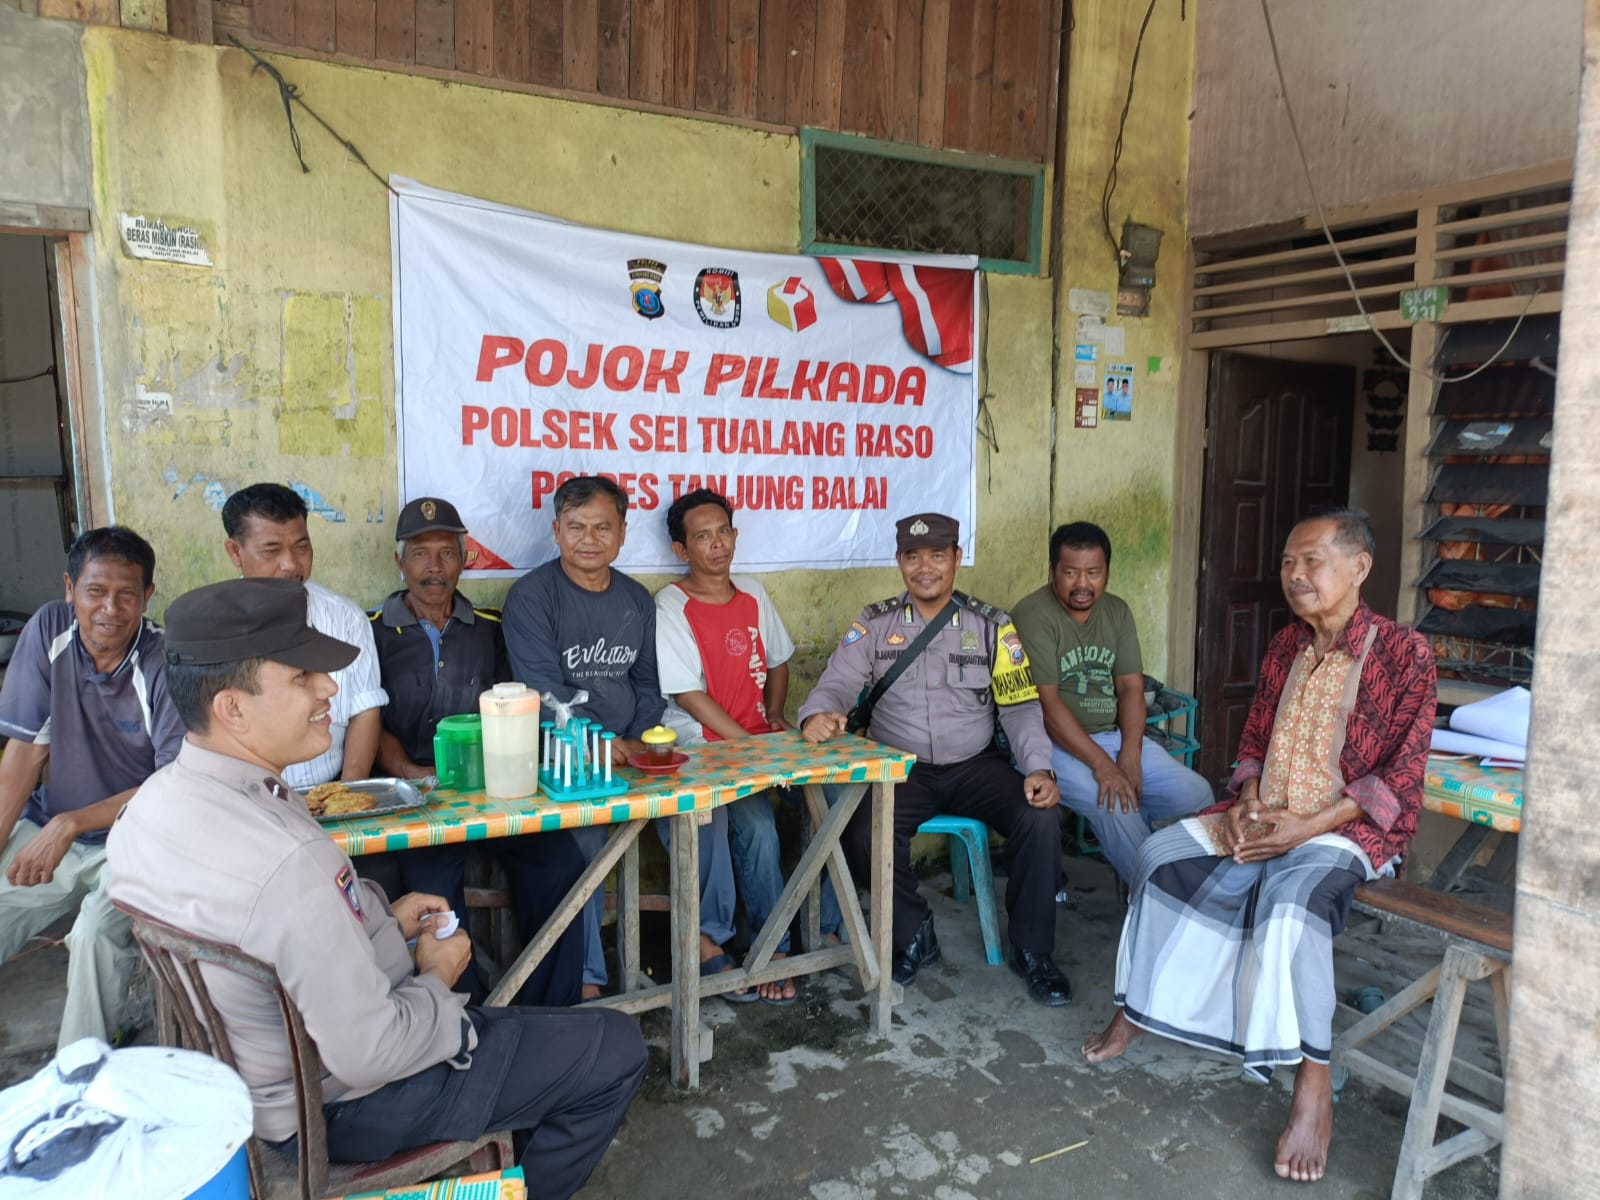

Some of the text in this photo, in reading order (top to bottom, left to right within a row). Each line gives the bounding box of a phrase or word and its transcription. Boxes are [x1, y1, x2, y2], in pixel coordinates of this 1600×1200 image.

[126, 228, 150, 244] BERAS
[151, 230, 177, 248] MISKIN
[476, 334, 927, 406] POJOK PILKADA
[461, 405, 934, 460] POLSEK SEI TUALANG RASO
[531, 470, 660, 511] PES
[811, 475, 888, 511] BALAI
